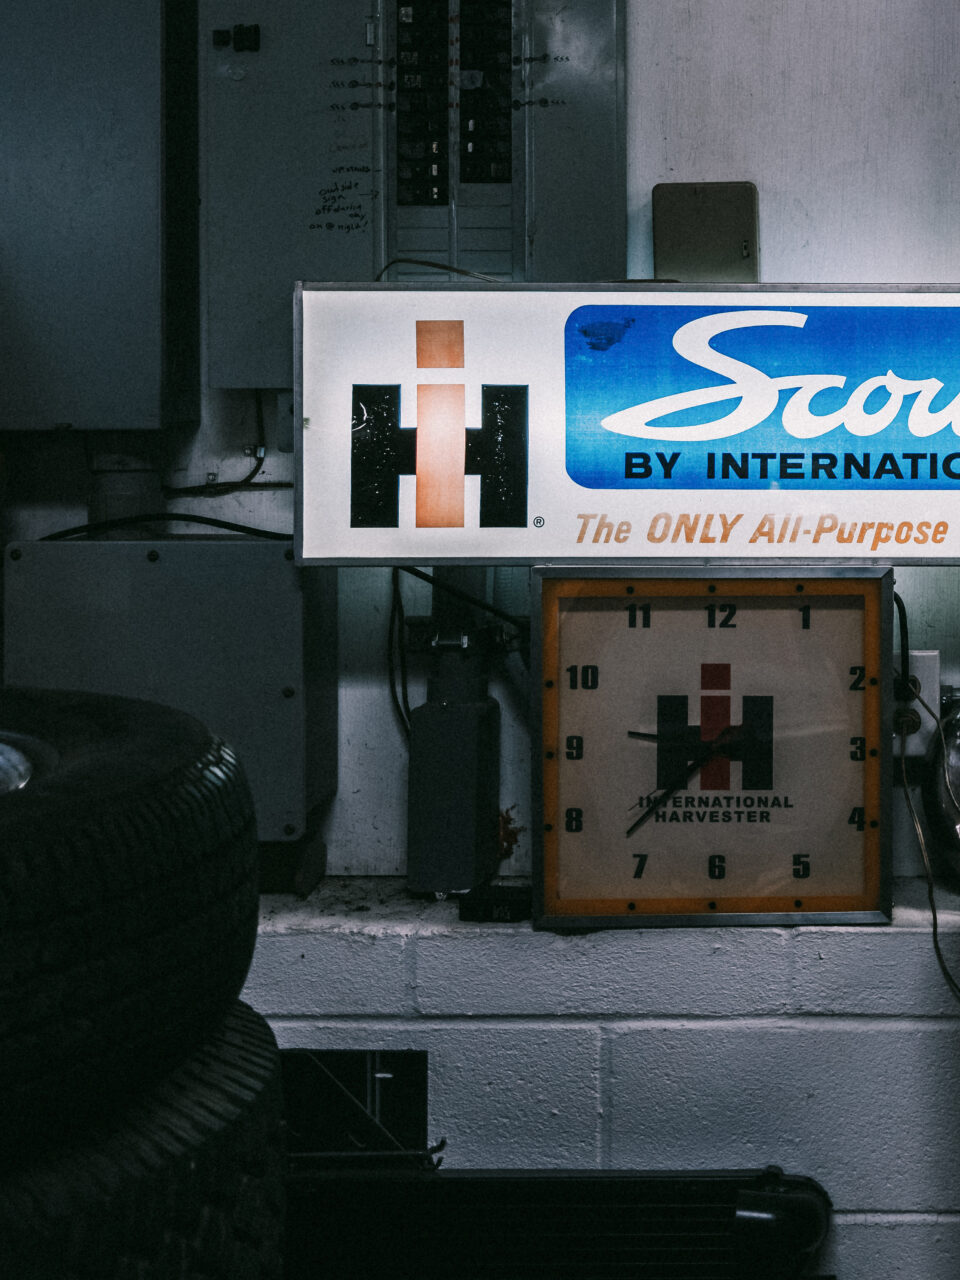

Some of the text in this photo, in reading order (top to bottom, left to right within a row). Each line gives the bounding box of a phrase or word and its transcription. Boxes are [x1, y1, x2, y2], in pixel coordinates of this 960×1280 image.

[624, 452, 681, 479] BY
[577, 512, 632, 544] The
[646, 512, 744, 544] ONLY
[751, 512, 949, 551] All-Purpose
[626, 604, 651, 628] 11
[704, 604, 737, 628] 12
[800, 605, 811, 630] 1
[566, 665, 599, 690] 10
[849, 666, 866, 691] 2
[566, 735, 583, 760] 9
[850, 736, 866, 761] 3
[638, 796, 794, 809] INTERNATIONAL
[565, 808, 583, 833] 8
[654, 810, 771, 823] HARVESTER
[848, 807, 865, 831] 4
[633, 854, 648, 879] 7
[708, 855, 726, 879] 6
[792, 854, 811, 879] 5
